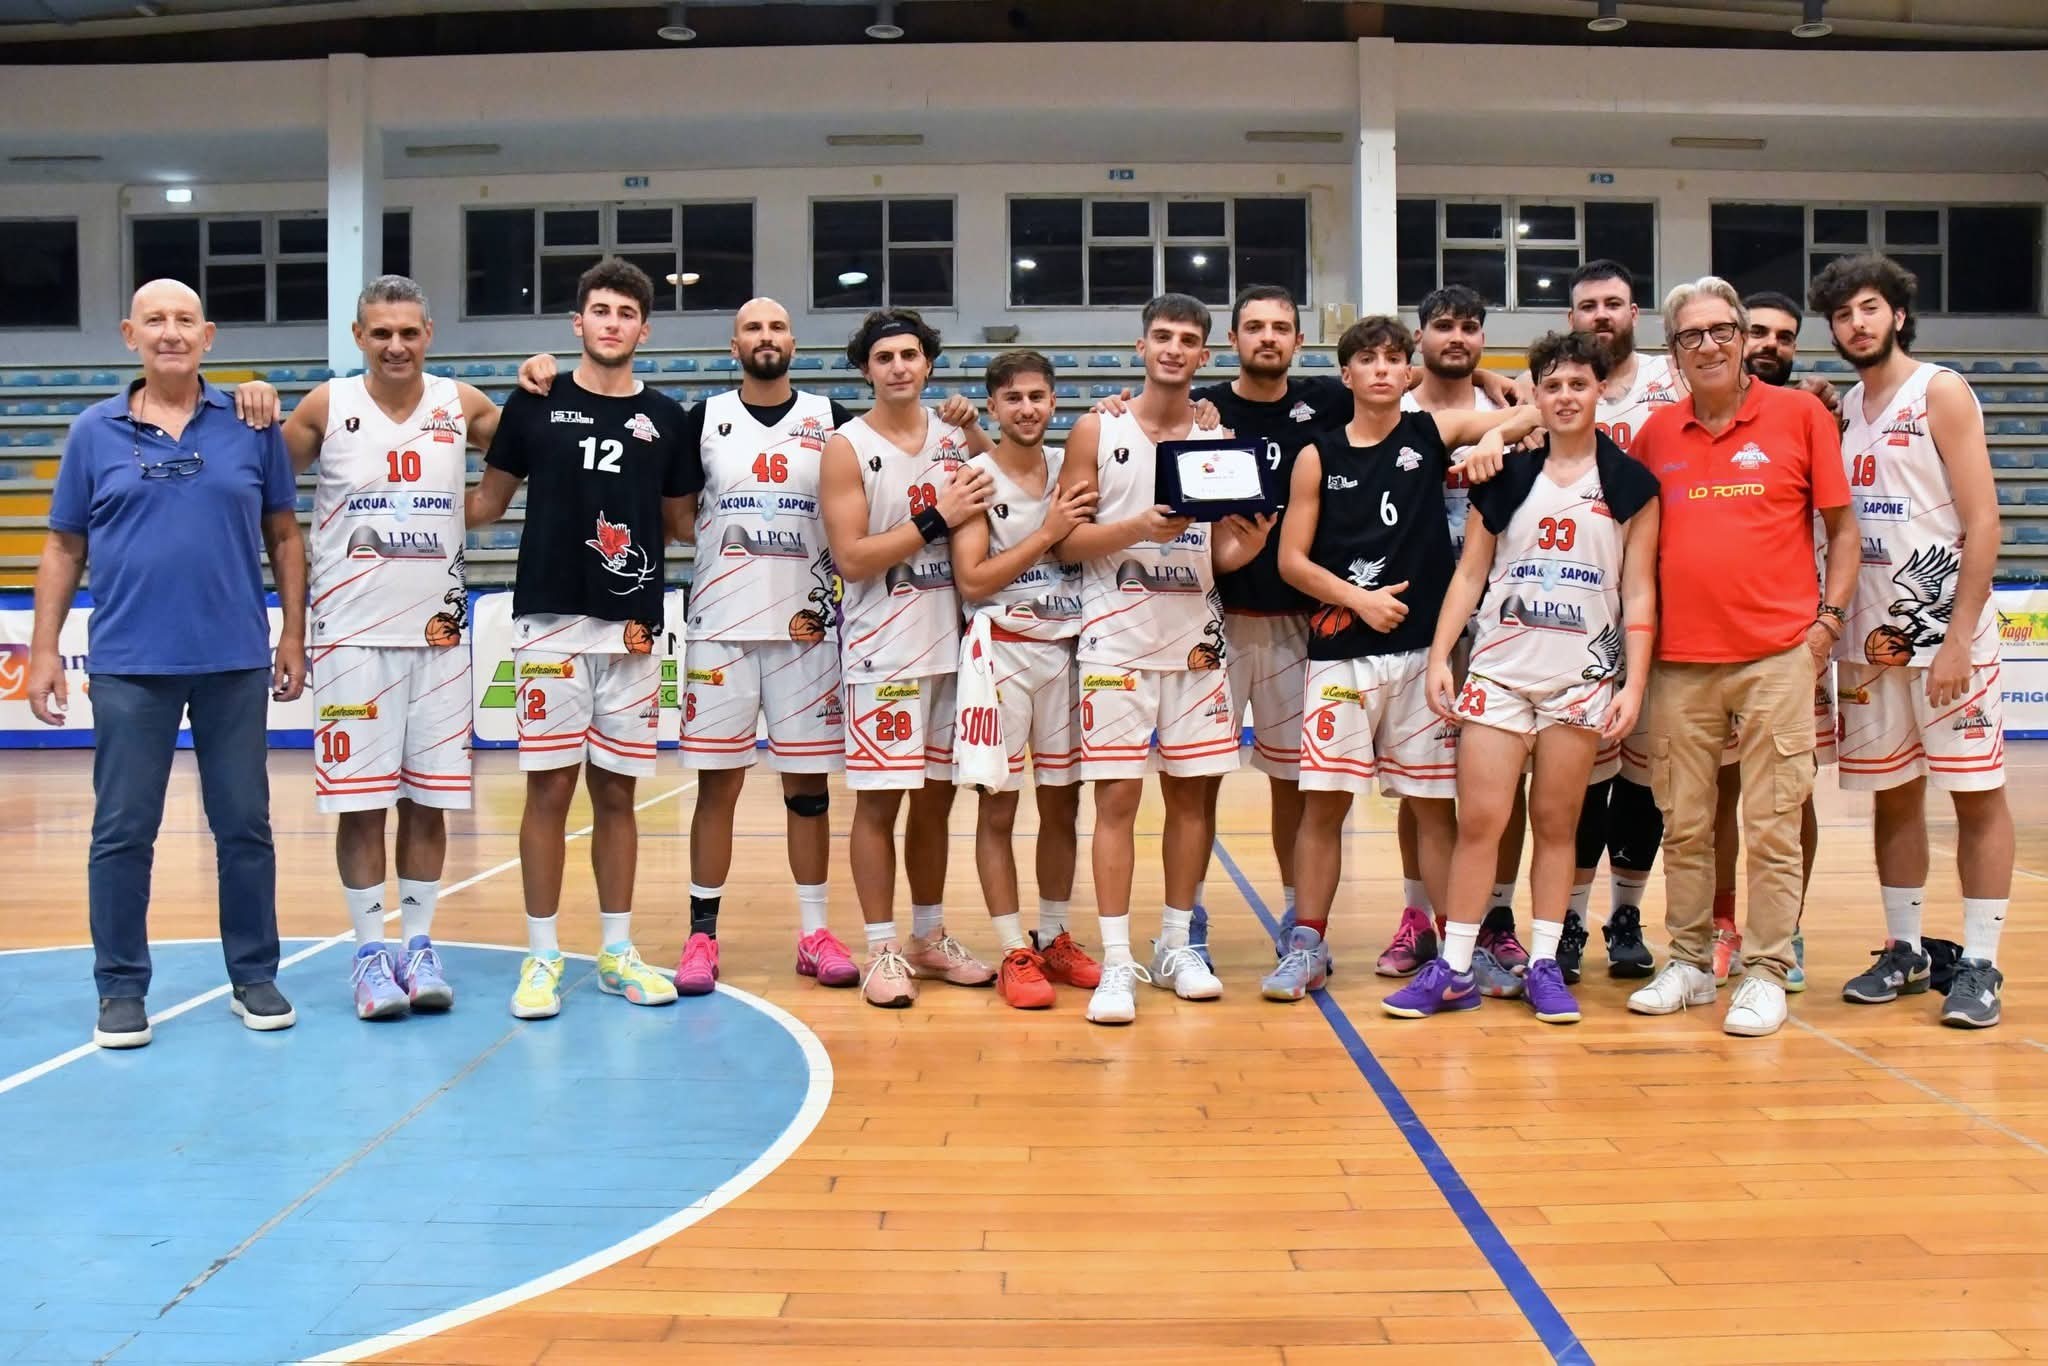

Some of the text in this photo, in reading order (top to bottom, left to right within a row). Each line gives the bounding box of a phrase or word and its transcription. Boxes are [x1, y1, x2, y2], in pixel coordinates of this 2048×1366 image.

[387, 451, 421, 482] 10
[579, 436, 624, 473] 12
[752, 453, 788, 483] 46
[1266, 442, 1281, 470] 9
[1851, 454, 1876, 486] 18
[348, 498, 387, 511] ACQUA
[720, 497, 755, 510] ACQUA
[907, 482, 938, 515] 28
[1688, 483, 1765, 499] LO PORTO
[1380, 490, 1398, 526] 6
[1863, 502, 1903, 515] SAPONE
[388, 532, 439, 548] LPCM
[756, 530, 802, 546] LPCM
[1538, 517, 1576, 551] 33
[1153, 566, 1199, 582] LPCM
[1511, 565, 1536, 578] CQUA
[1533, 601, 1582, 622] LPCM
[876, 710, 912, 741] 28
[1317, 710, 1335, 741] 6
[322, 731, 350, 763] 10
